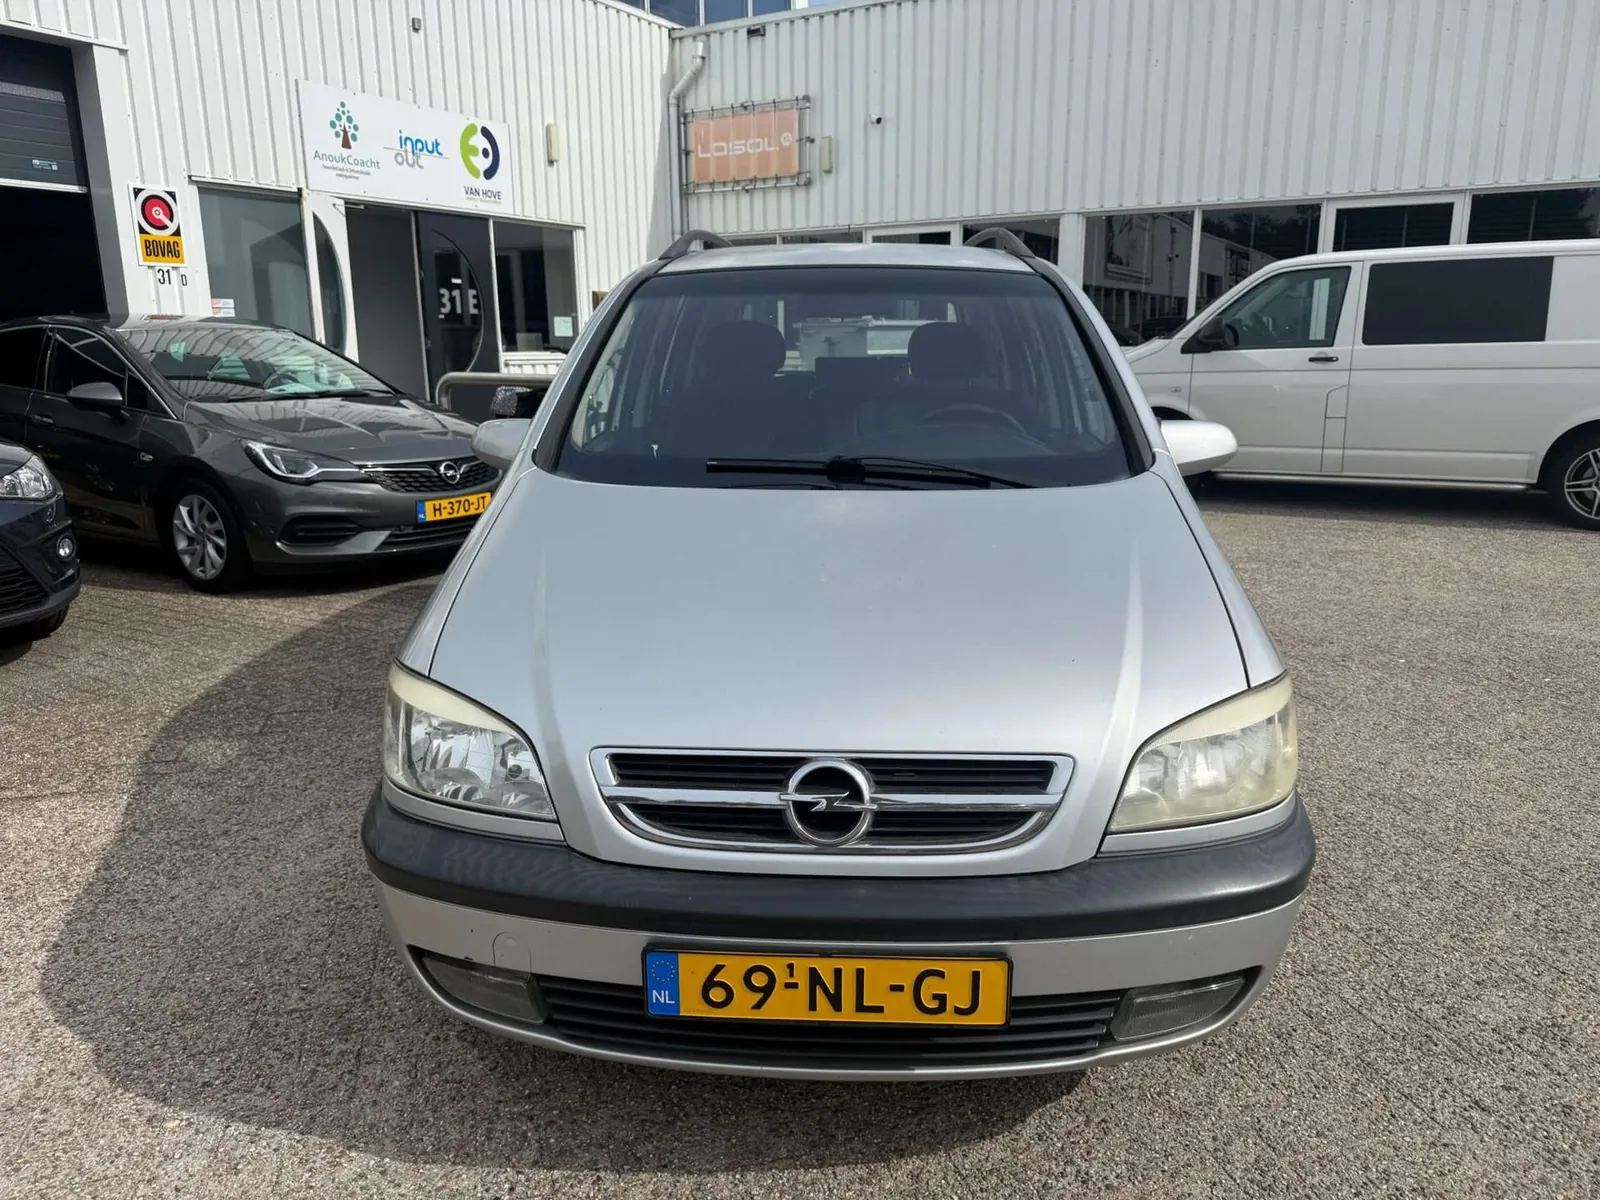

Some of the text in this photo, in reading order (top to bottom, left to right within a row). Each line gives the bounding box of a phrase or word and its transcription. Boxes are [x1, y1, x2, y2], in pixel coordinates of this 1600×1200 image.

[399, 129, 443, 156] input
[313, 150, 380, 170] AnoukCoacht
[394, 148, 424, 170] out
[463, 186, 481, 197] VAN
[481, 189, 502, 201] HOVE
[144, 239, 181, 259] BOVAG
[157, 268, 188, 286] 31 D
[433, 496, 487, 517] H-370-JT
[652, 989, 675, 1004] NL
